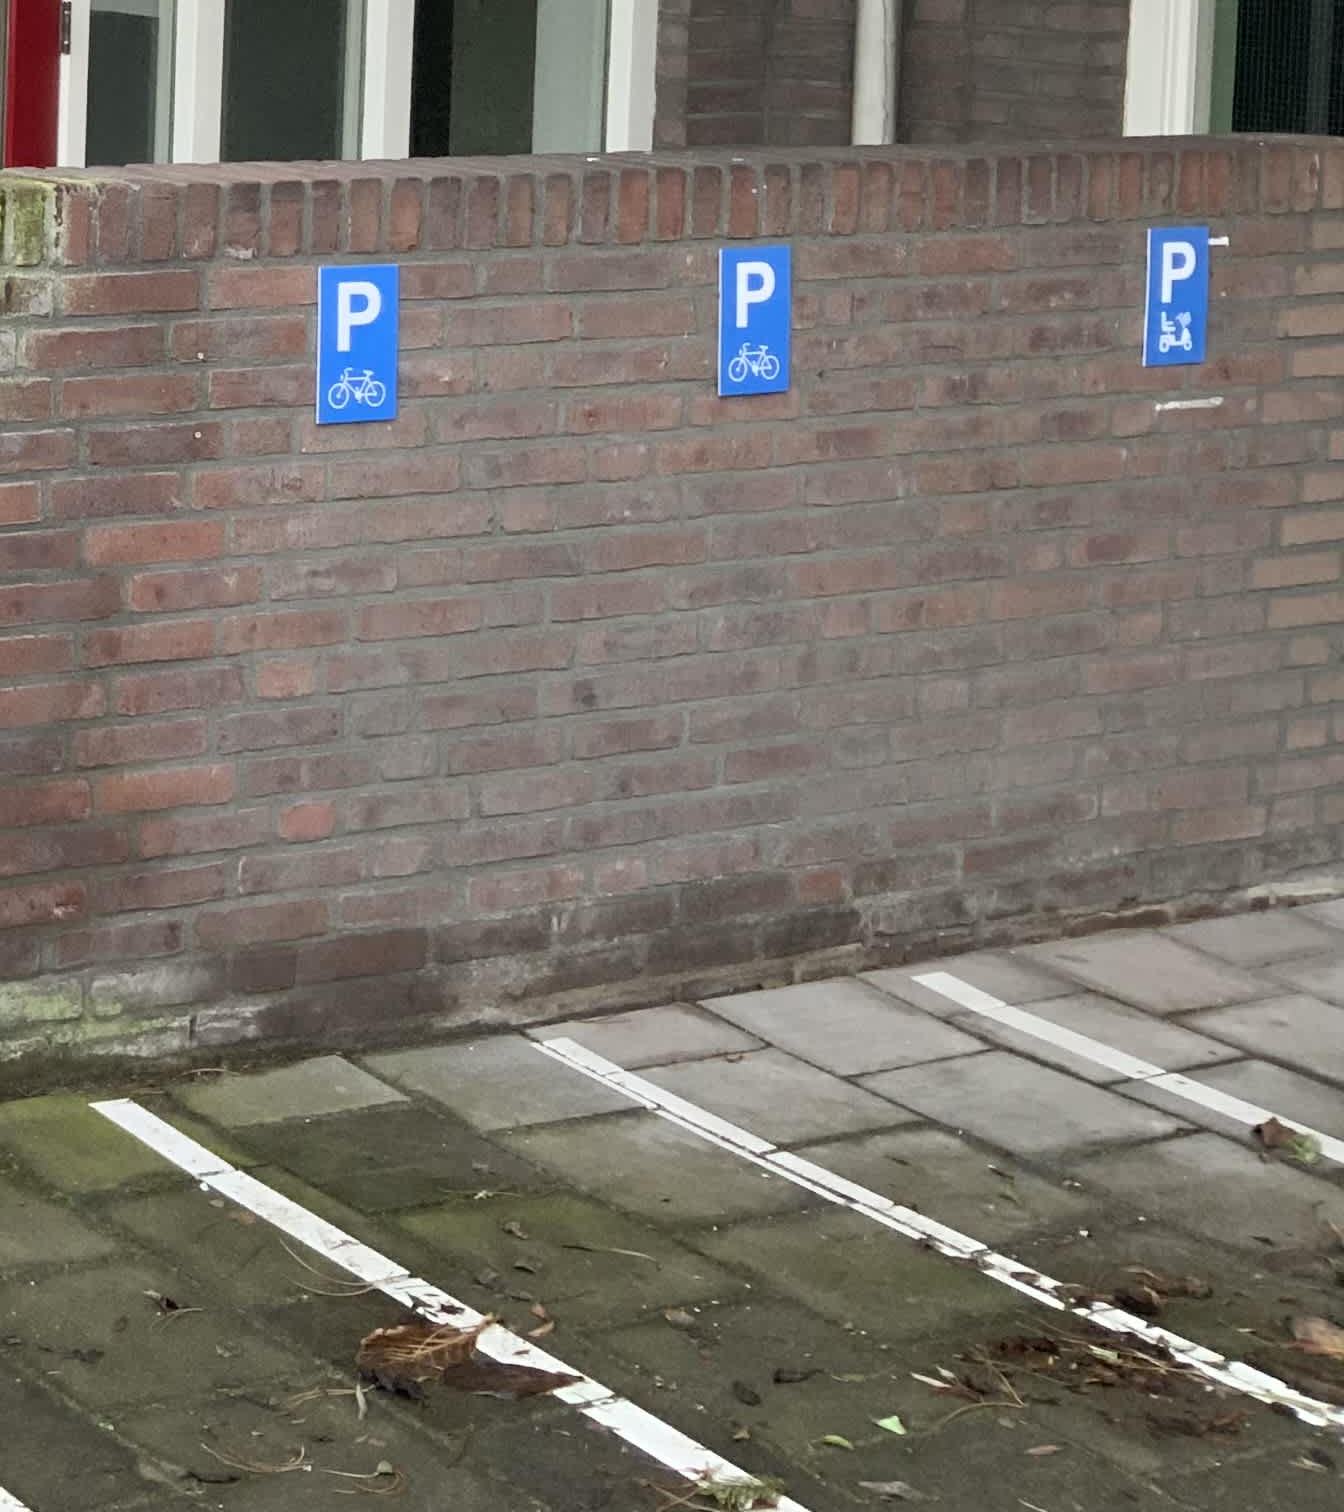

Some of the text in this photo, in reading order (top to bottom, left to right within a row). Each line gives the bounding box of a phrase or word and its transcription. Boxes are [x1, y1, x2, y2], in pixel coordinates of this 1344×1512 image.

[735, 261, 776, 329] P
[1161, 241, 1197, 304] P
[336, 281, 382, 353] P
